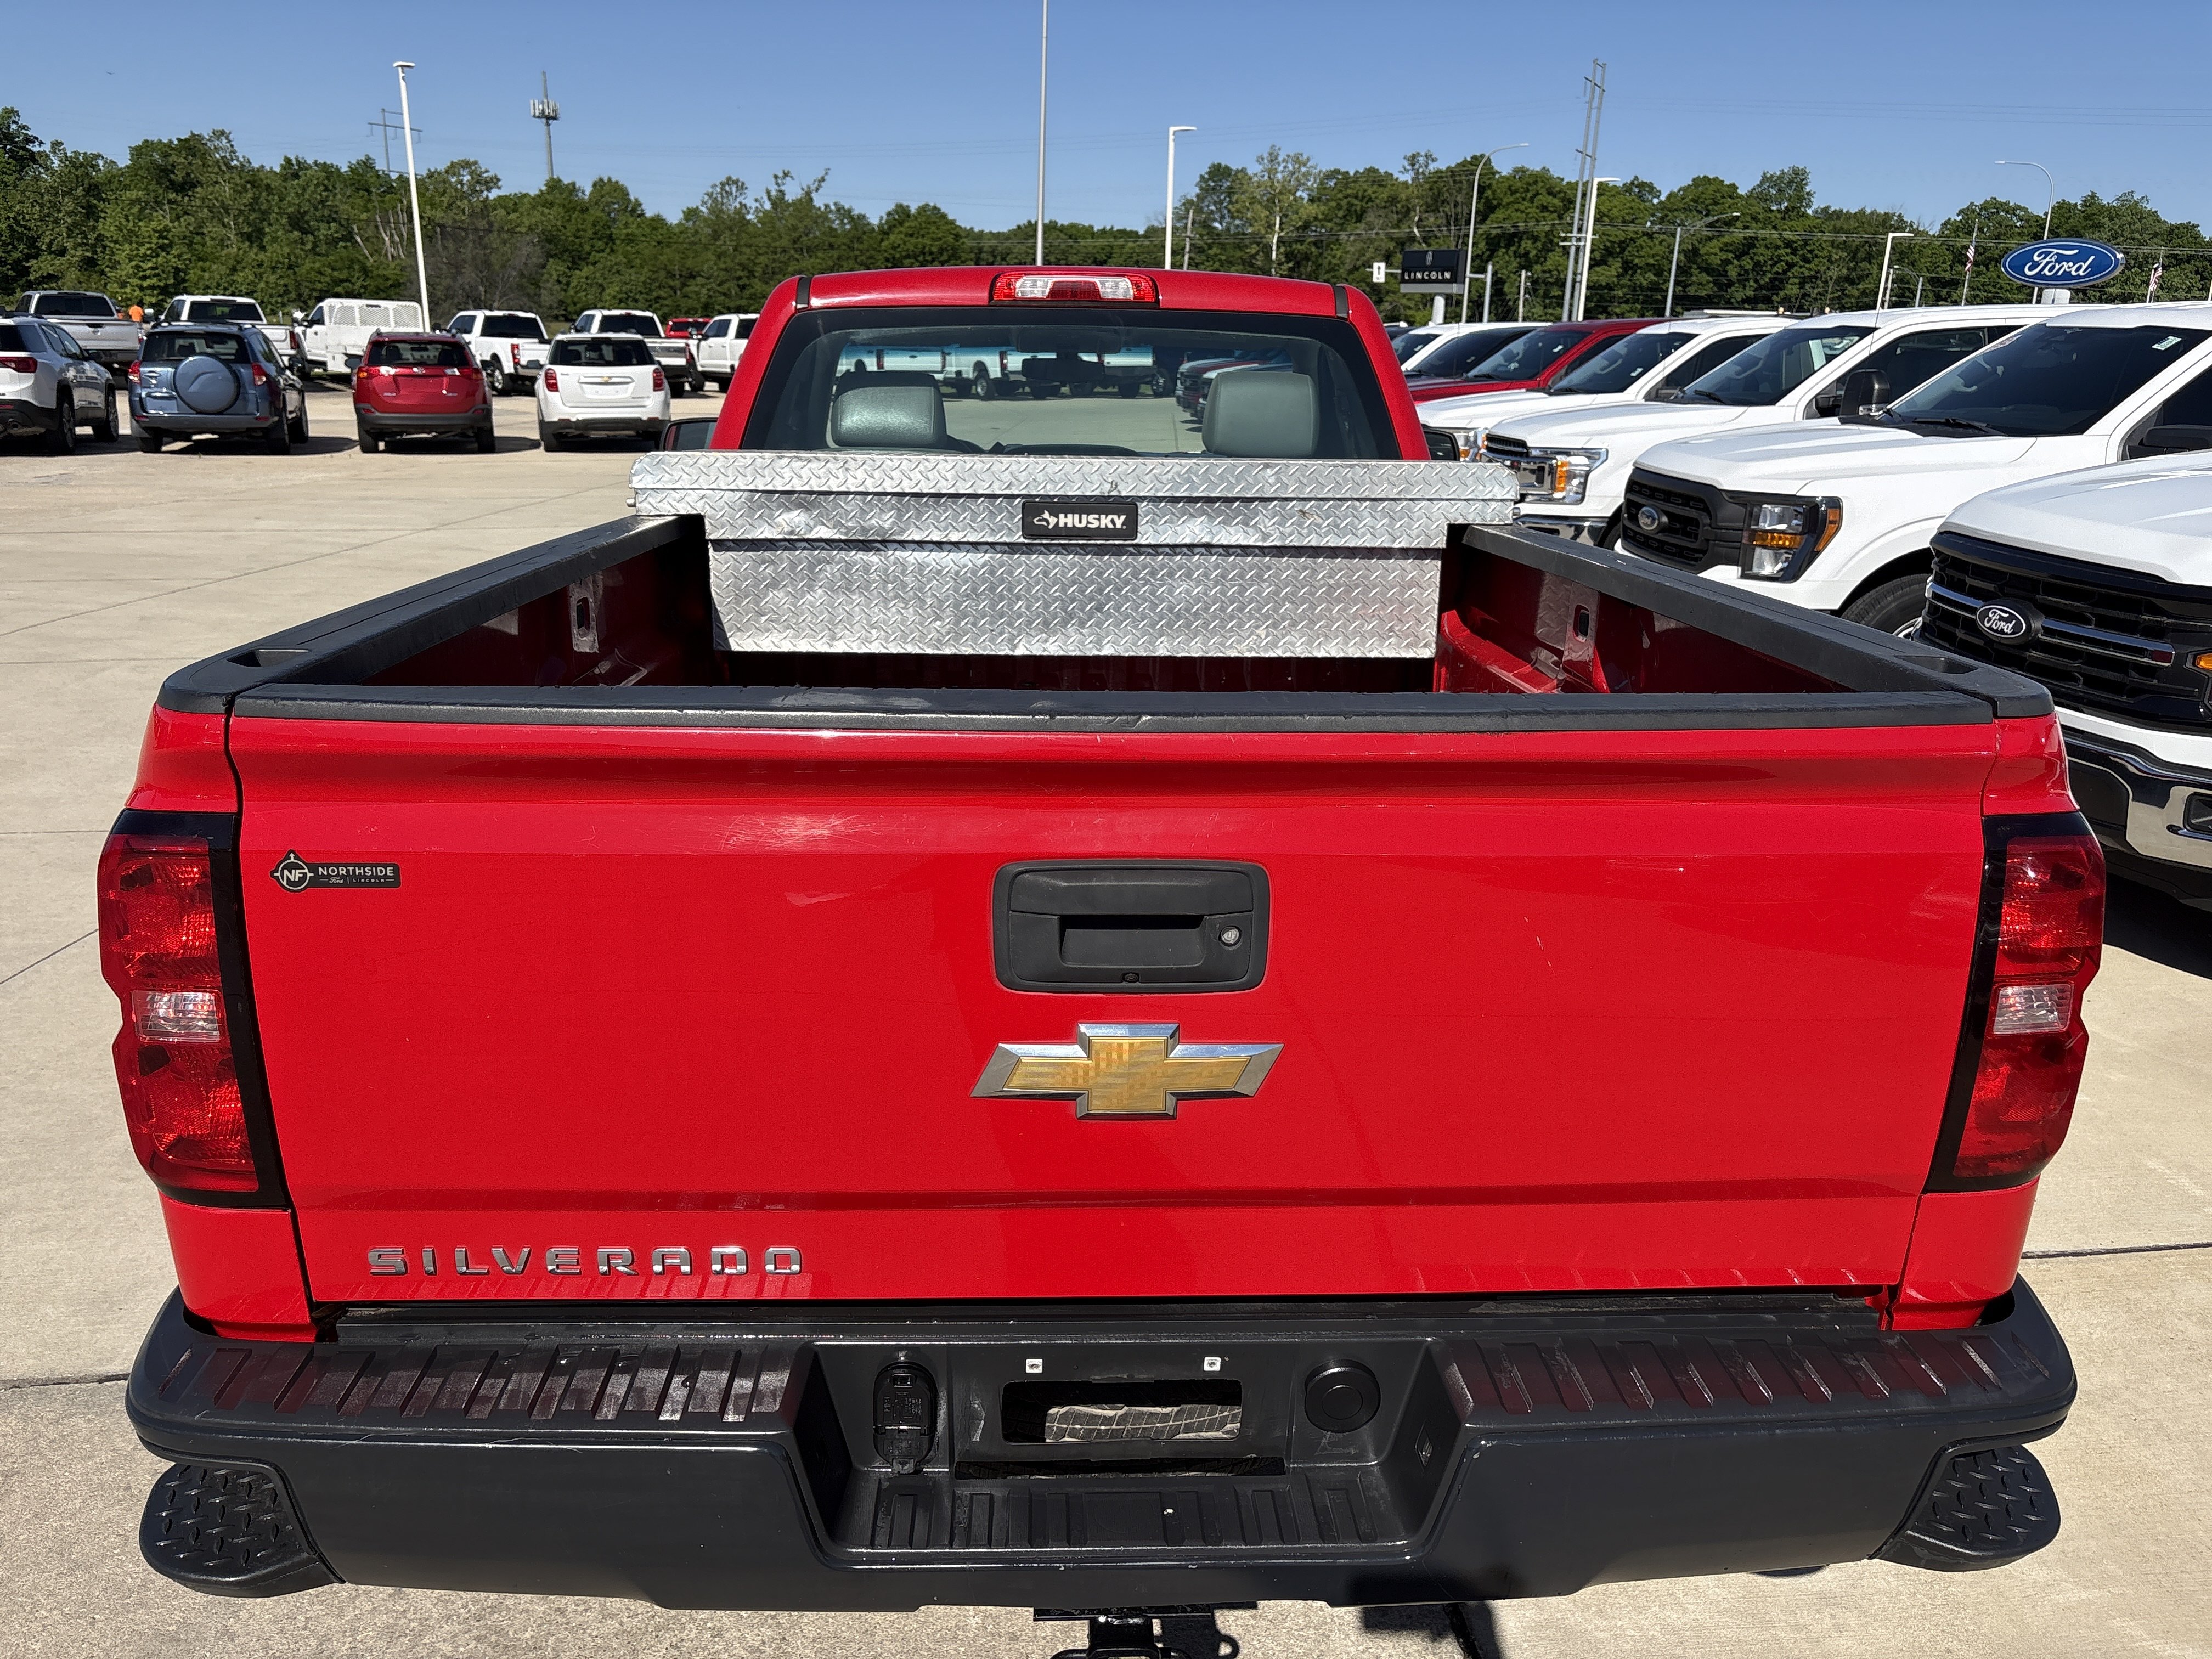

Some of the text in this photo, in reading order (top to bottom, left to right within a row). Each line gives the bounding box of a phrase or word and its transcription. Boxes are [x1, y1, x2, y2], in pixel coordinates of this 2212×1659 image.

[2024, 248, 2096, 276] Ford
[1404, 270, 1451, 280] LINCOLN
[1058, 514, 1126, 529] HUSKY
[1984, 608, 2016, 634] Ford
[283, 869, 307, 883] NF
[318, 866, 394, 876] NORTHSIDE
[368, 1245, 803, 1276] SILVERADO
